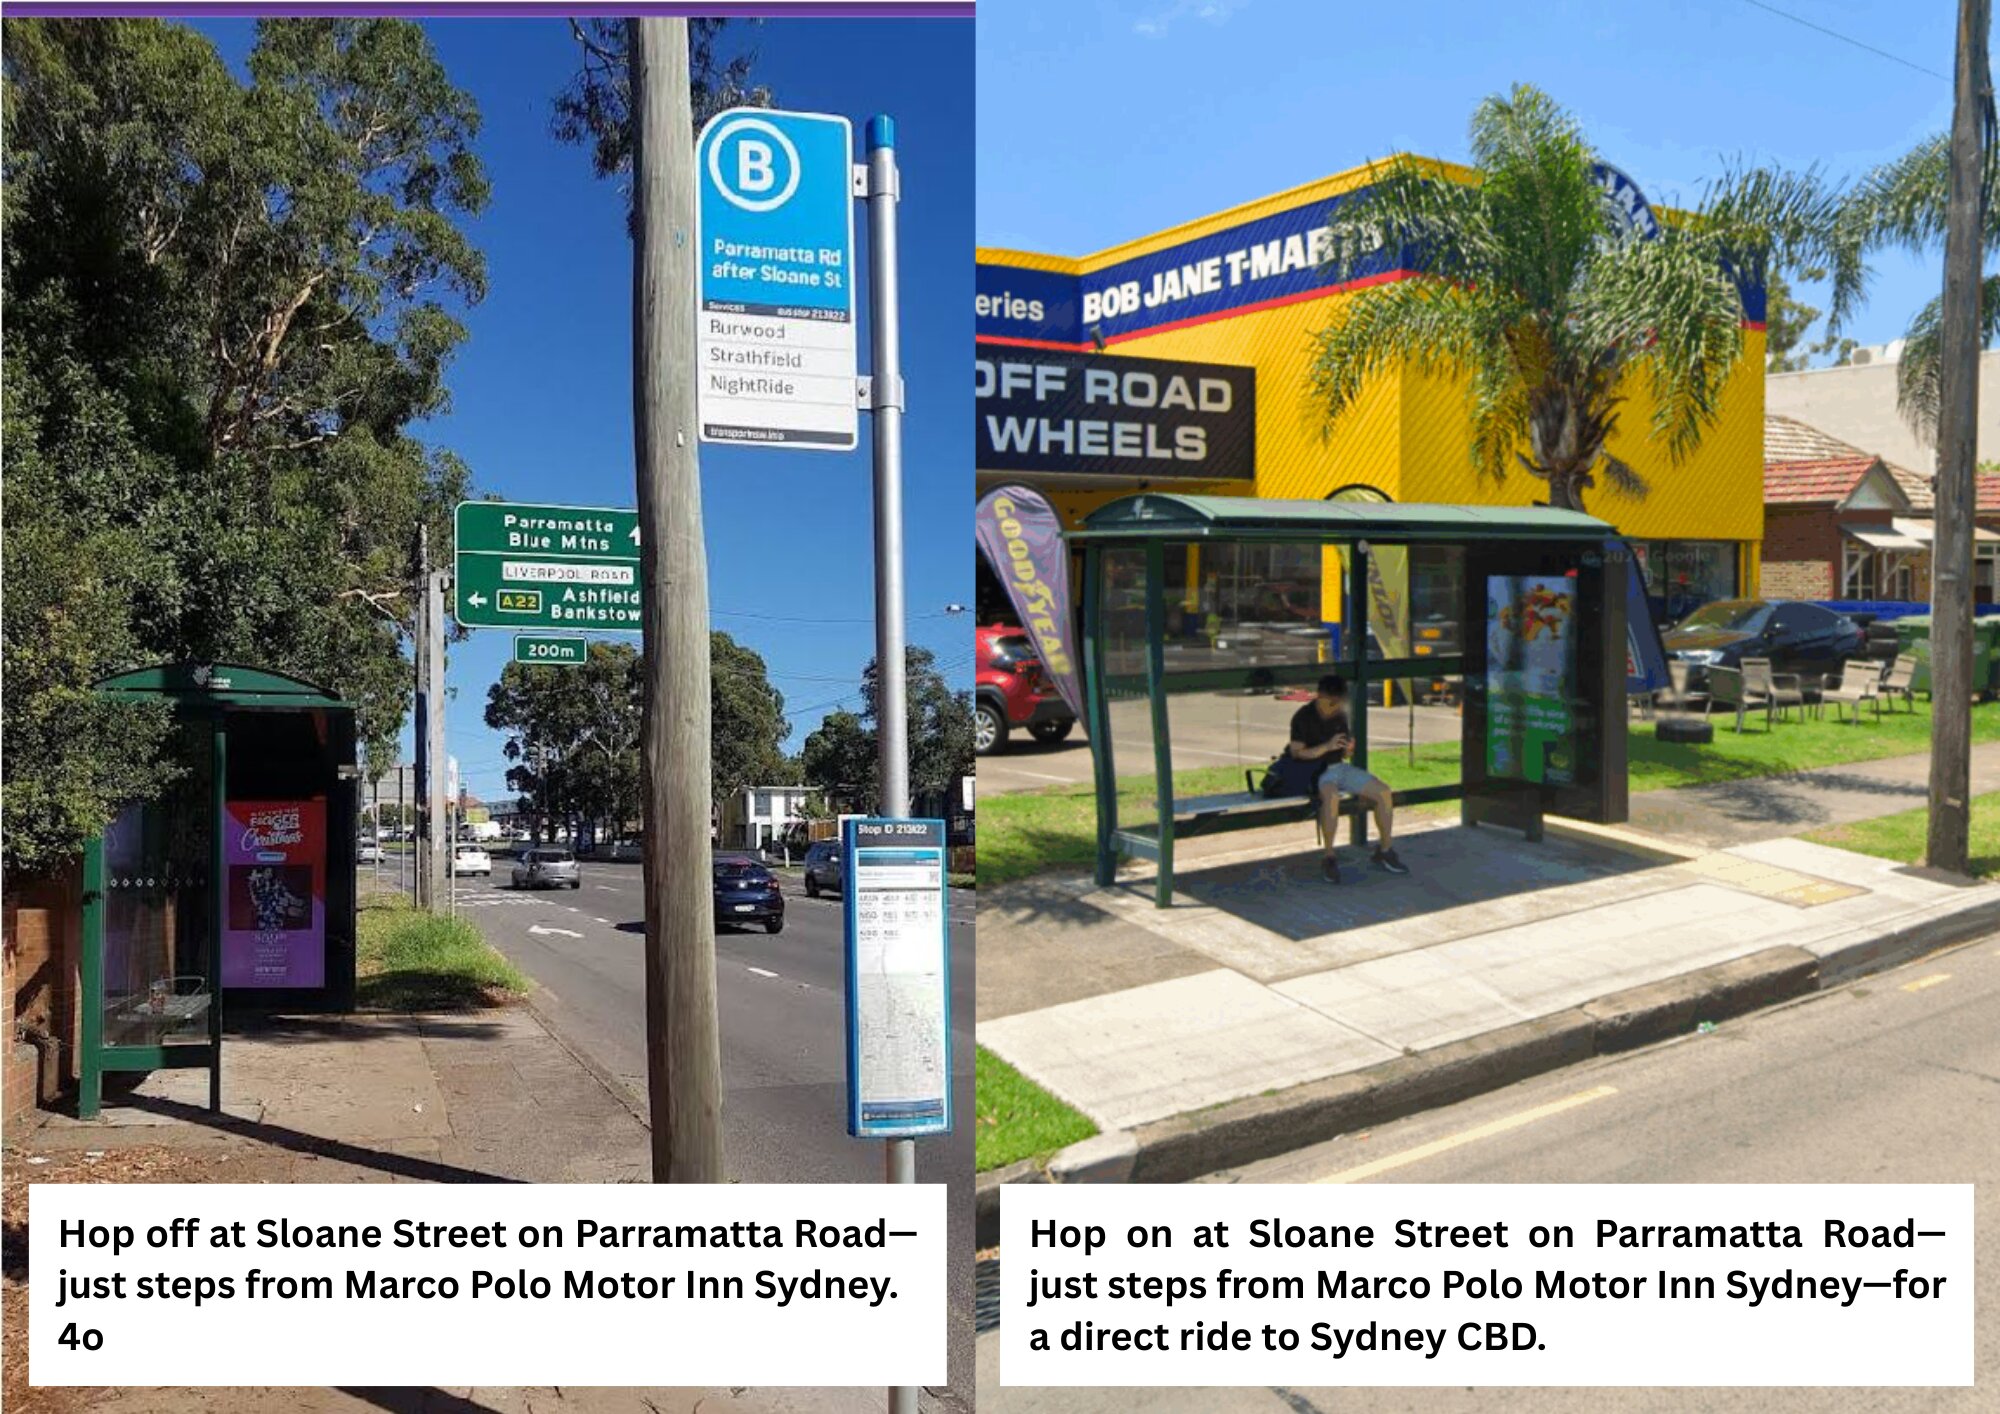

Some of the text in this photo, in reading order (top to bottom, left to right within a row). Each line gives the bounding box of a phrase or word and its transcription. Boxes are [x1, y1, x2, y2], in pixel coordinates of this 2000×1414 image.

[738, 139, 775, 192] B
[714, 238, 842, 266] Parramatta Rd
[712, 261, 842, 288] after Sloane St
[1082, 281, 1140, 324] BOB
[1144, 257, 1221, 307] JANE
[710, 319, 785, 339] Burwood
[710, 346, 802, 368] Strathfield
[710, 375, 794, 396] NightRide
[975, 360, 1232, 413] OFF ROAD
[987, 415, 1207, 461] WHEELS
[504, 514, 613, 533] Parramatta
[509, 531, 610, 551] Blue Mtns
[505, 566, 629, 580] LIVERPOOL ROAD
[502, 594, 537, 608] A22
[562, 586, 640, 604] Ashfield
[551, 604, 641, 621] Bankstow
[528, 643, 575, 658] 200m
[858, 824, 881, 835] Stop
